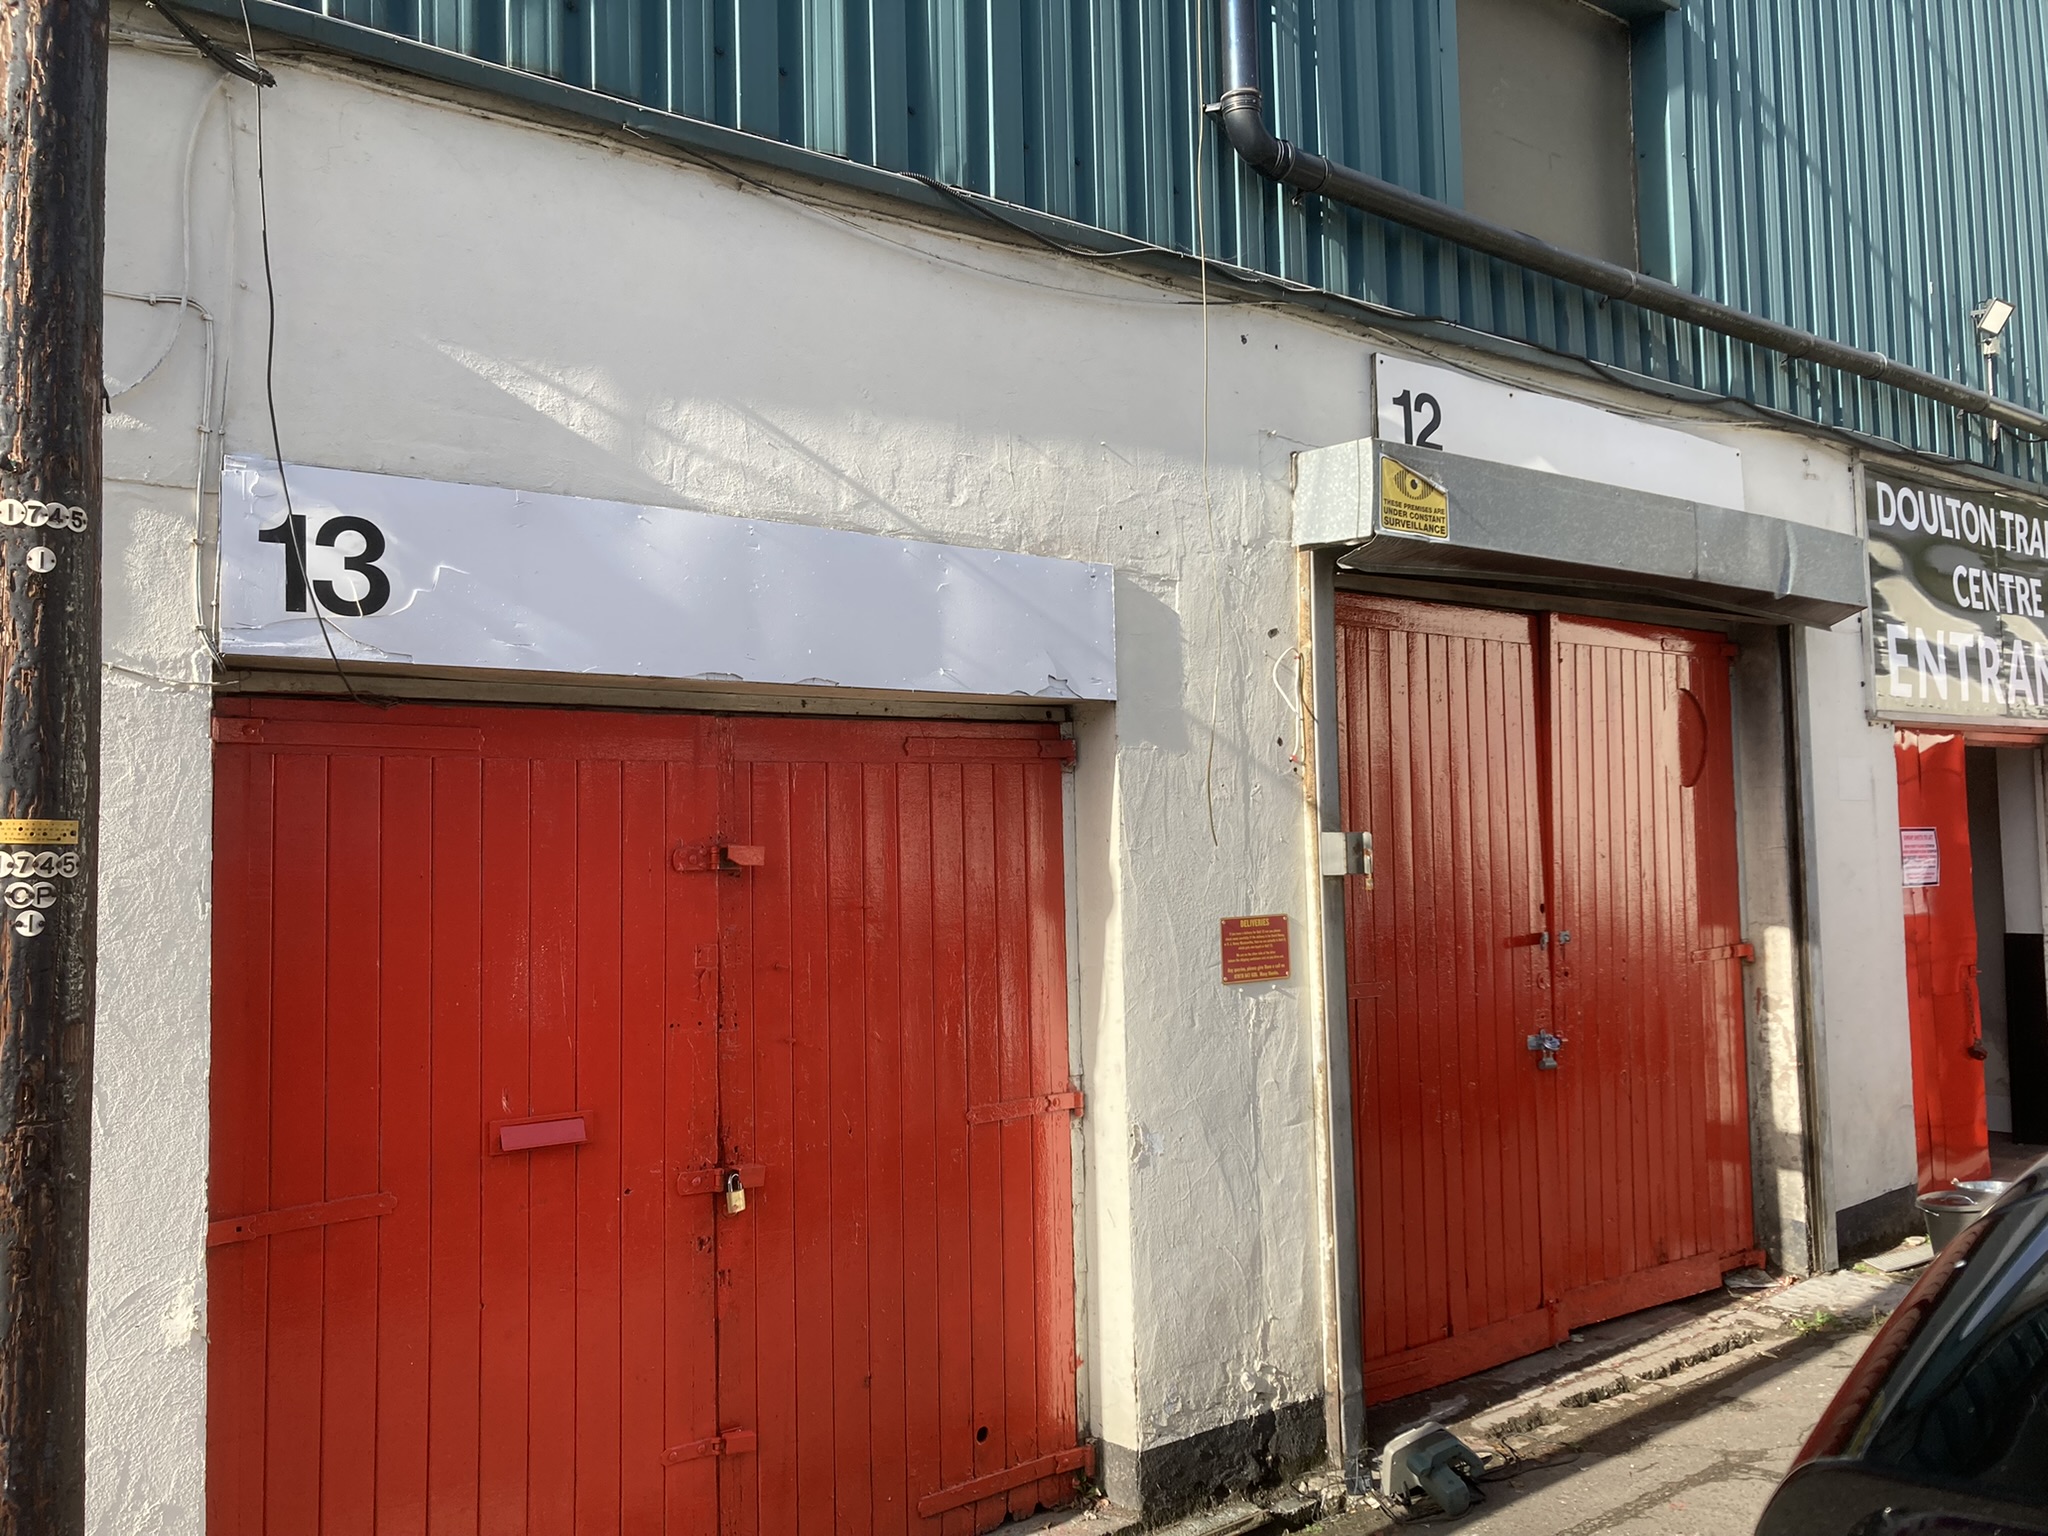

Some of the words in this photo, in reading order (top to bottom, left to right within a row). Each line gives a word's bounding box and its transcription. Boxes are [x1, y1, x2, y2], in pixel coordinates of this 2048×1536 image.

[1391, 388, 1444, 452] 12
[6, 501, 85, 530] 1745
[1383, 498, 1402, 509] THESE
[1403, 503, 1432, 514] PREMISES
[1433, 507, 1445, 516] ARE
[1383, 506, 1408, 519] UNDER
[1409, 511, 1446, 525] CONSTANT
[1875, 480, 1997, 549] DOULTON
[1999, 510, 2048, 560] TRA
[1383, 515, 1446, 536] SURVEILLANCE
[258, 513, 391, 617] 13
[1952, 564, 2046, 619] CENTRE
[1240, 918, 1270, 928] DELIVERIES
